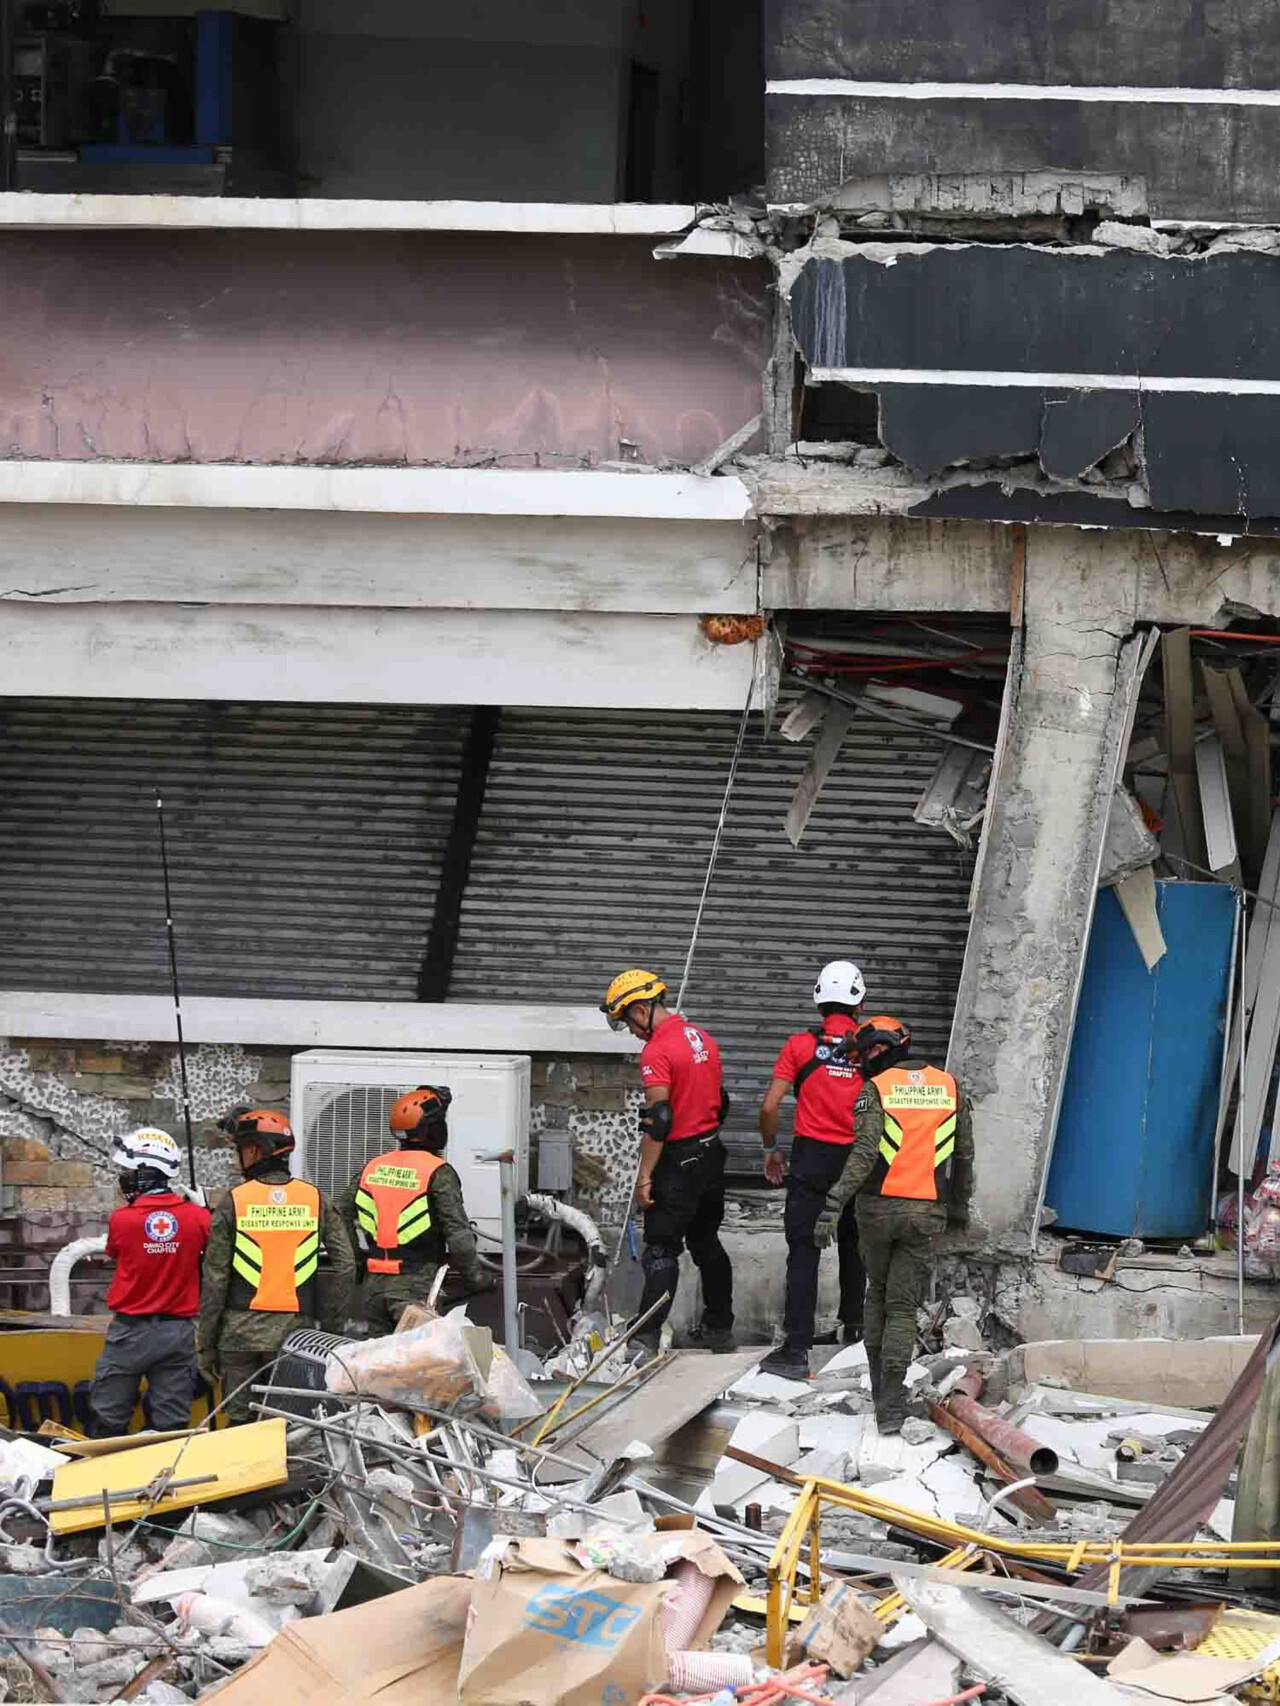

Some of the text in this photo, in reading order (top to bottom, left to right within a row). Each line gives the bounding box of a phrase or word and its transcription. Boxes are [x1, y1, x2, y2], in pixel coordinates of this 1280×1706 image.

[828, 1069, 853, 1079] CHAPTER
[894, 1085, 944, 1097] PHILIPPINE ARMY
[888, 1097, 913, 1105] DISASTER
[913, 1097, 940, 1106] RESPONSE
[377, 1166, 415, 1180] PHILIPPINE ARMY
[251, 1206, 306, 1218] PHILIPPINE ARMY
[240, 1219, 315, 1228] DISASTER RESPONSE UNIT
